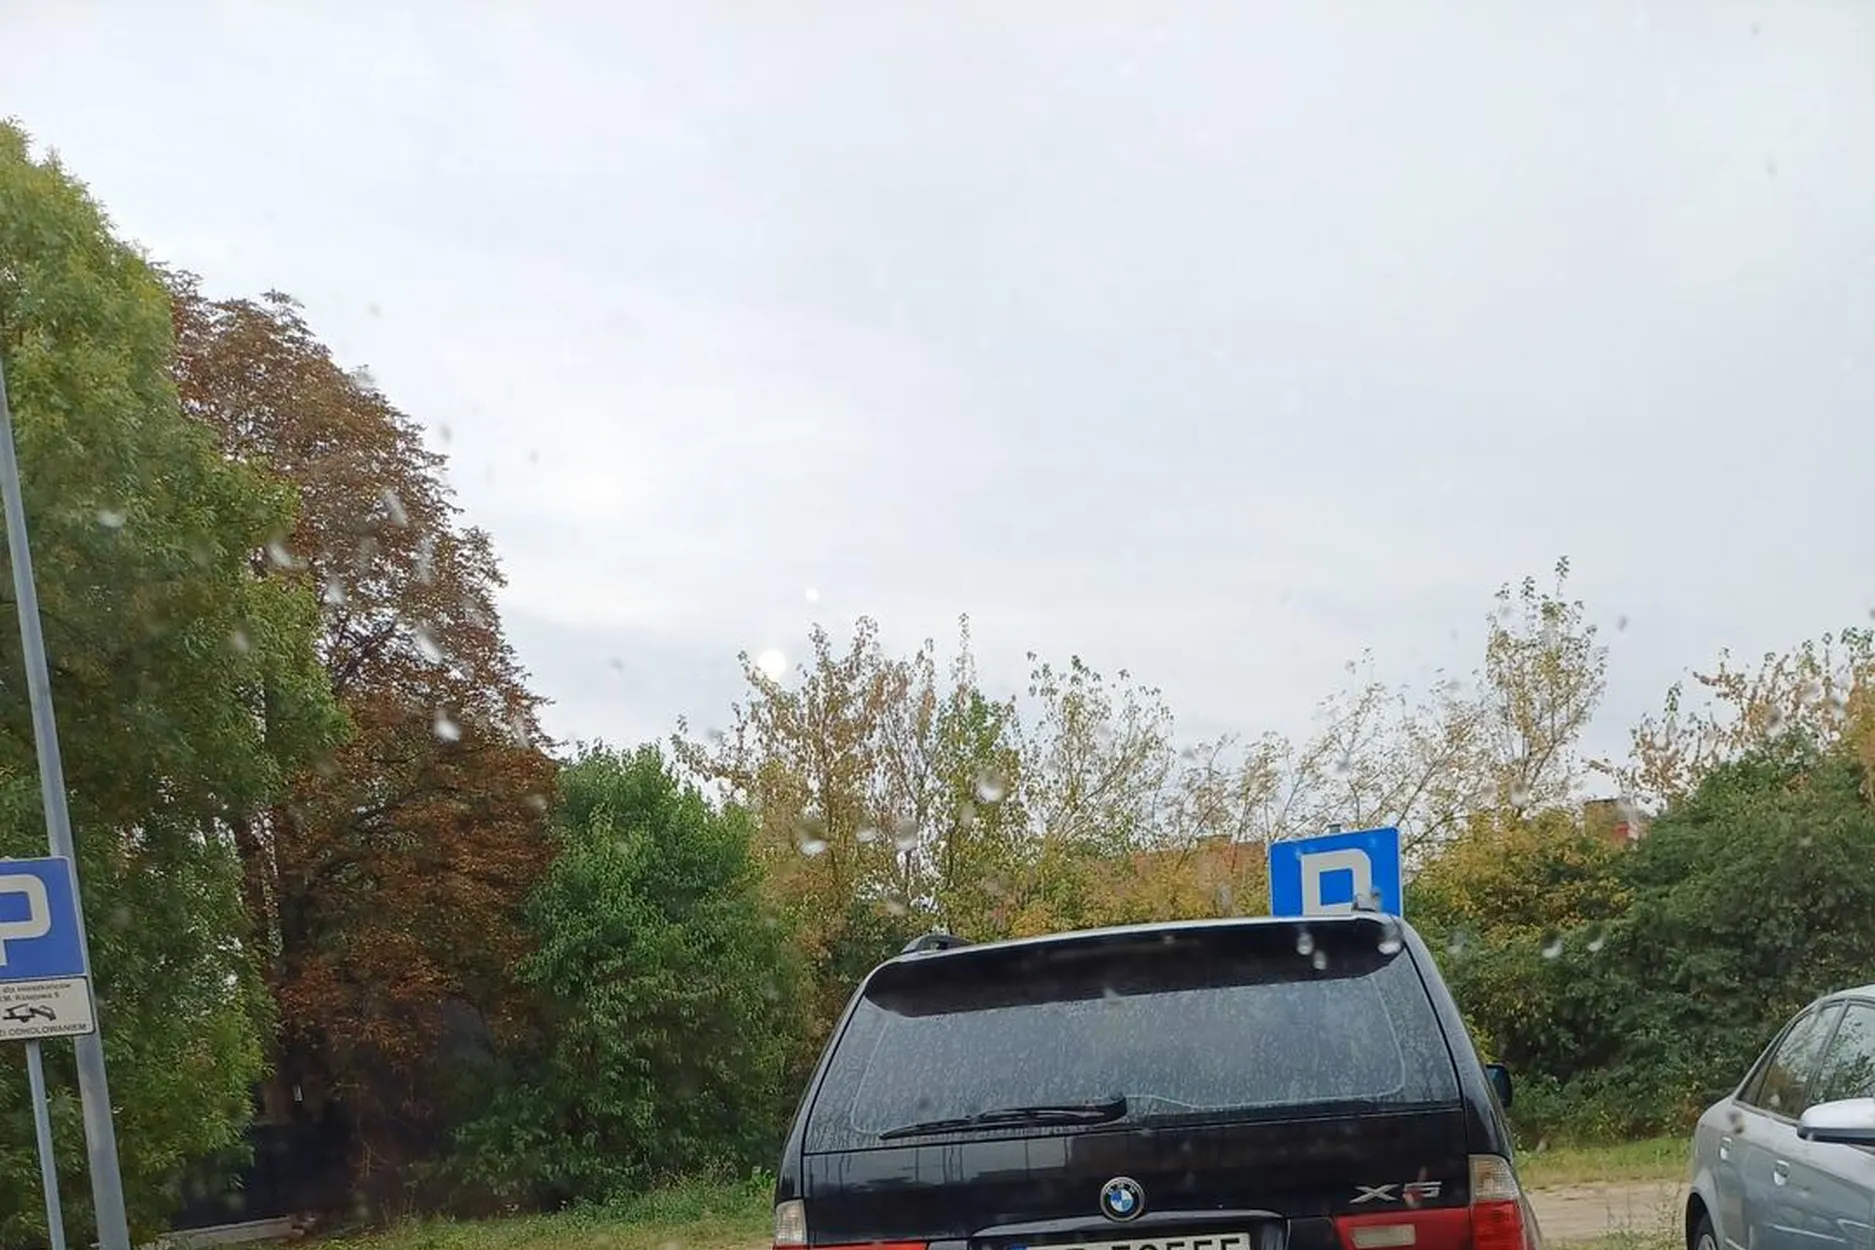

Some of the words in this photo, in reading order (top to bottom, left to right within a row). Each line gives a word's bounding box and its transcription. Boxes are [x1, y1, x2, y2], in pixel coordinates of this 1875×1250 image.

[1301, 848, 1371, 916] P
[0, 874, 51, 966] P
[1349, 1181, 1442, 1203] X5
